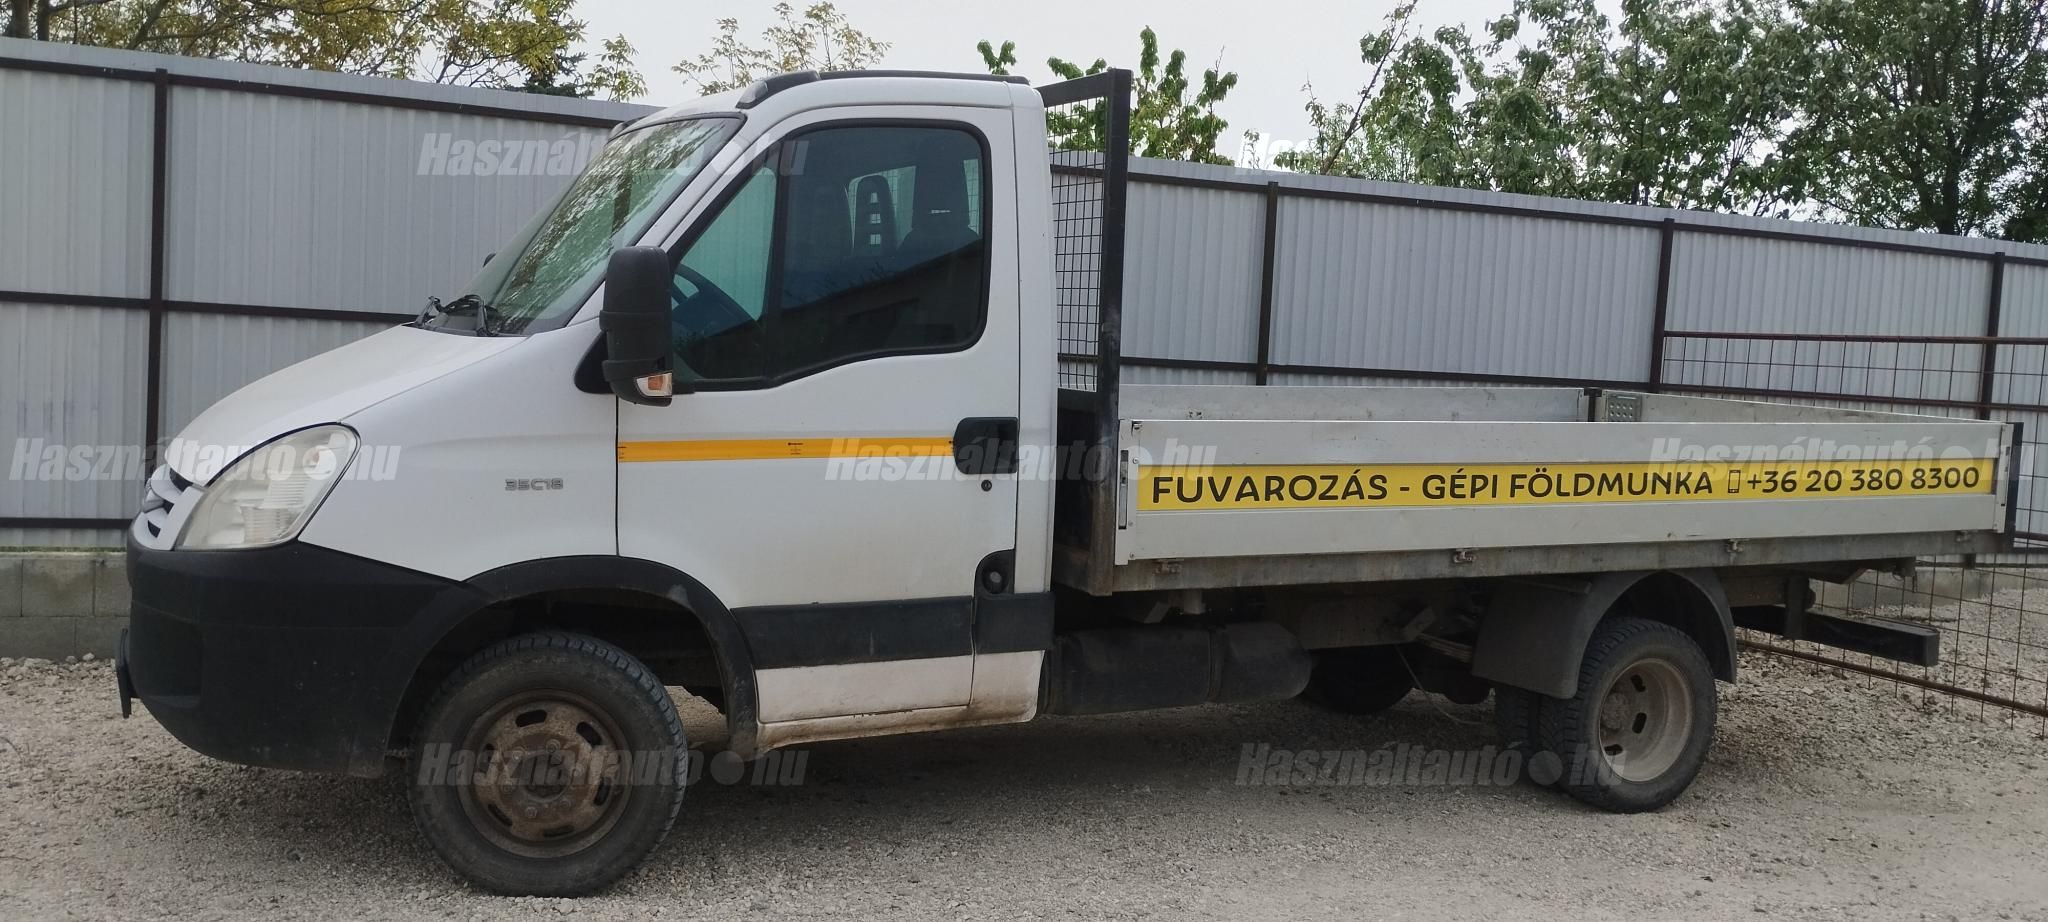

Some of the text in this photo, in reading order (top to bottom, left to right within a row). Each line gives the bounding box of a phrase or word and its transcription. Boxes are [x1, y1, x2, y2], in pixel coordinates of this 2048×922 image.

[1152, 469, 1388, 503] FUVAROZÁS
[1422, 468, 1498, 499] GÉPI
[1509, 467, 1713, 498] FÖLDMUNKA
[1747, 470, 1797, 493] +36
[1805, 470, 1842, 492] 20
[1850, 468, 1902, 491] 380
[1910, 467, 1979, 489] 8300
